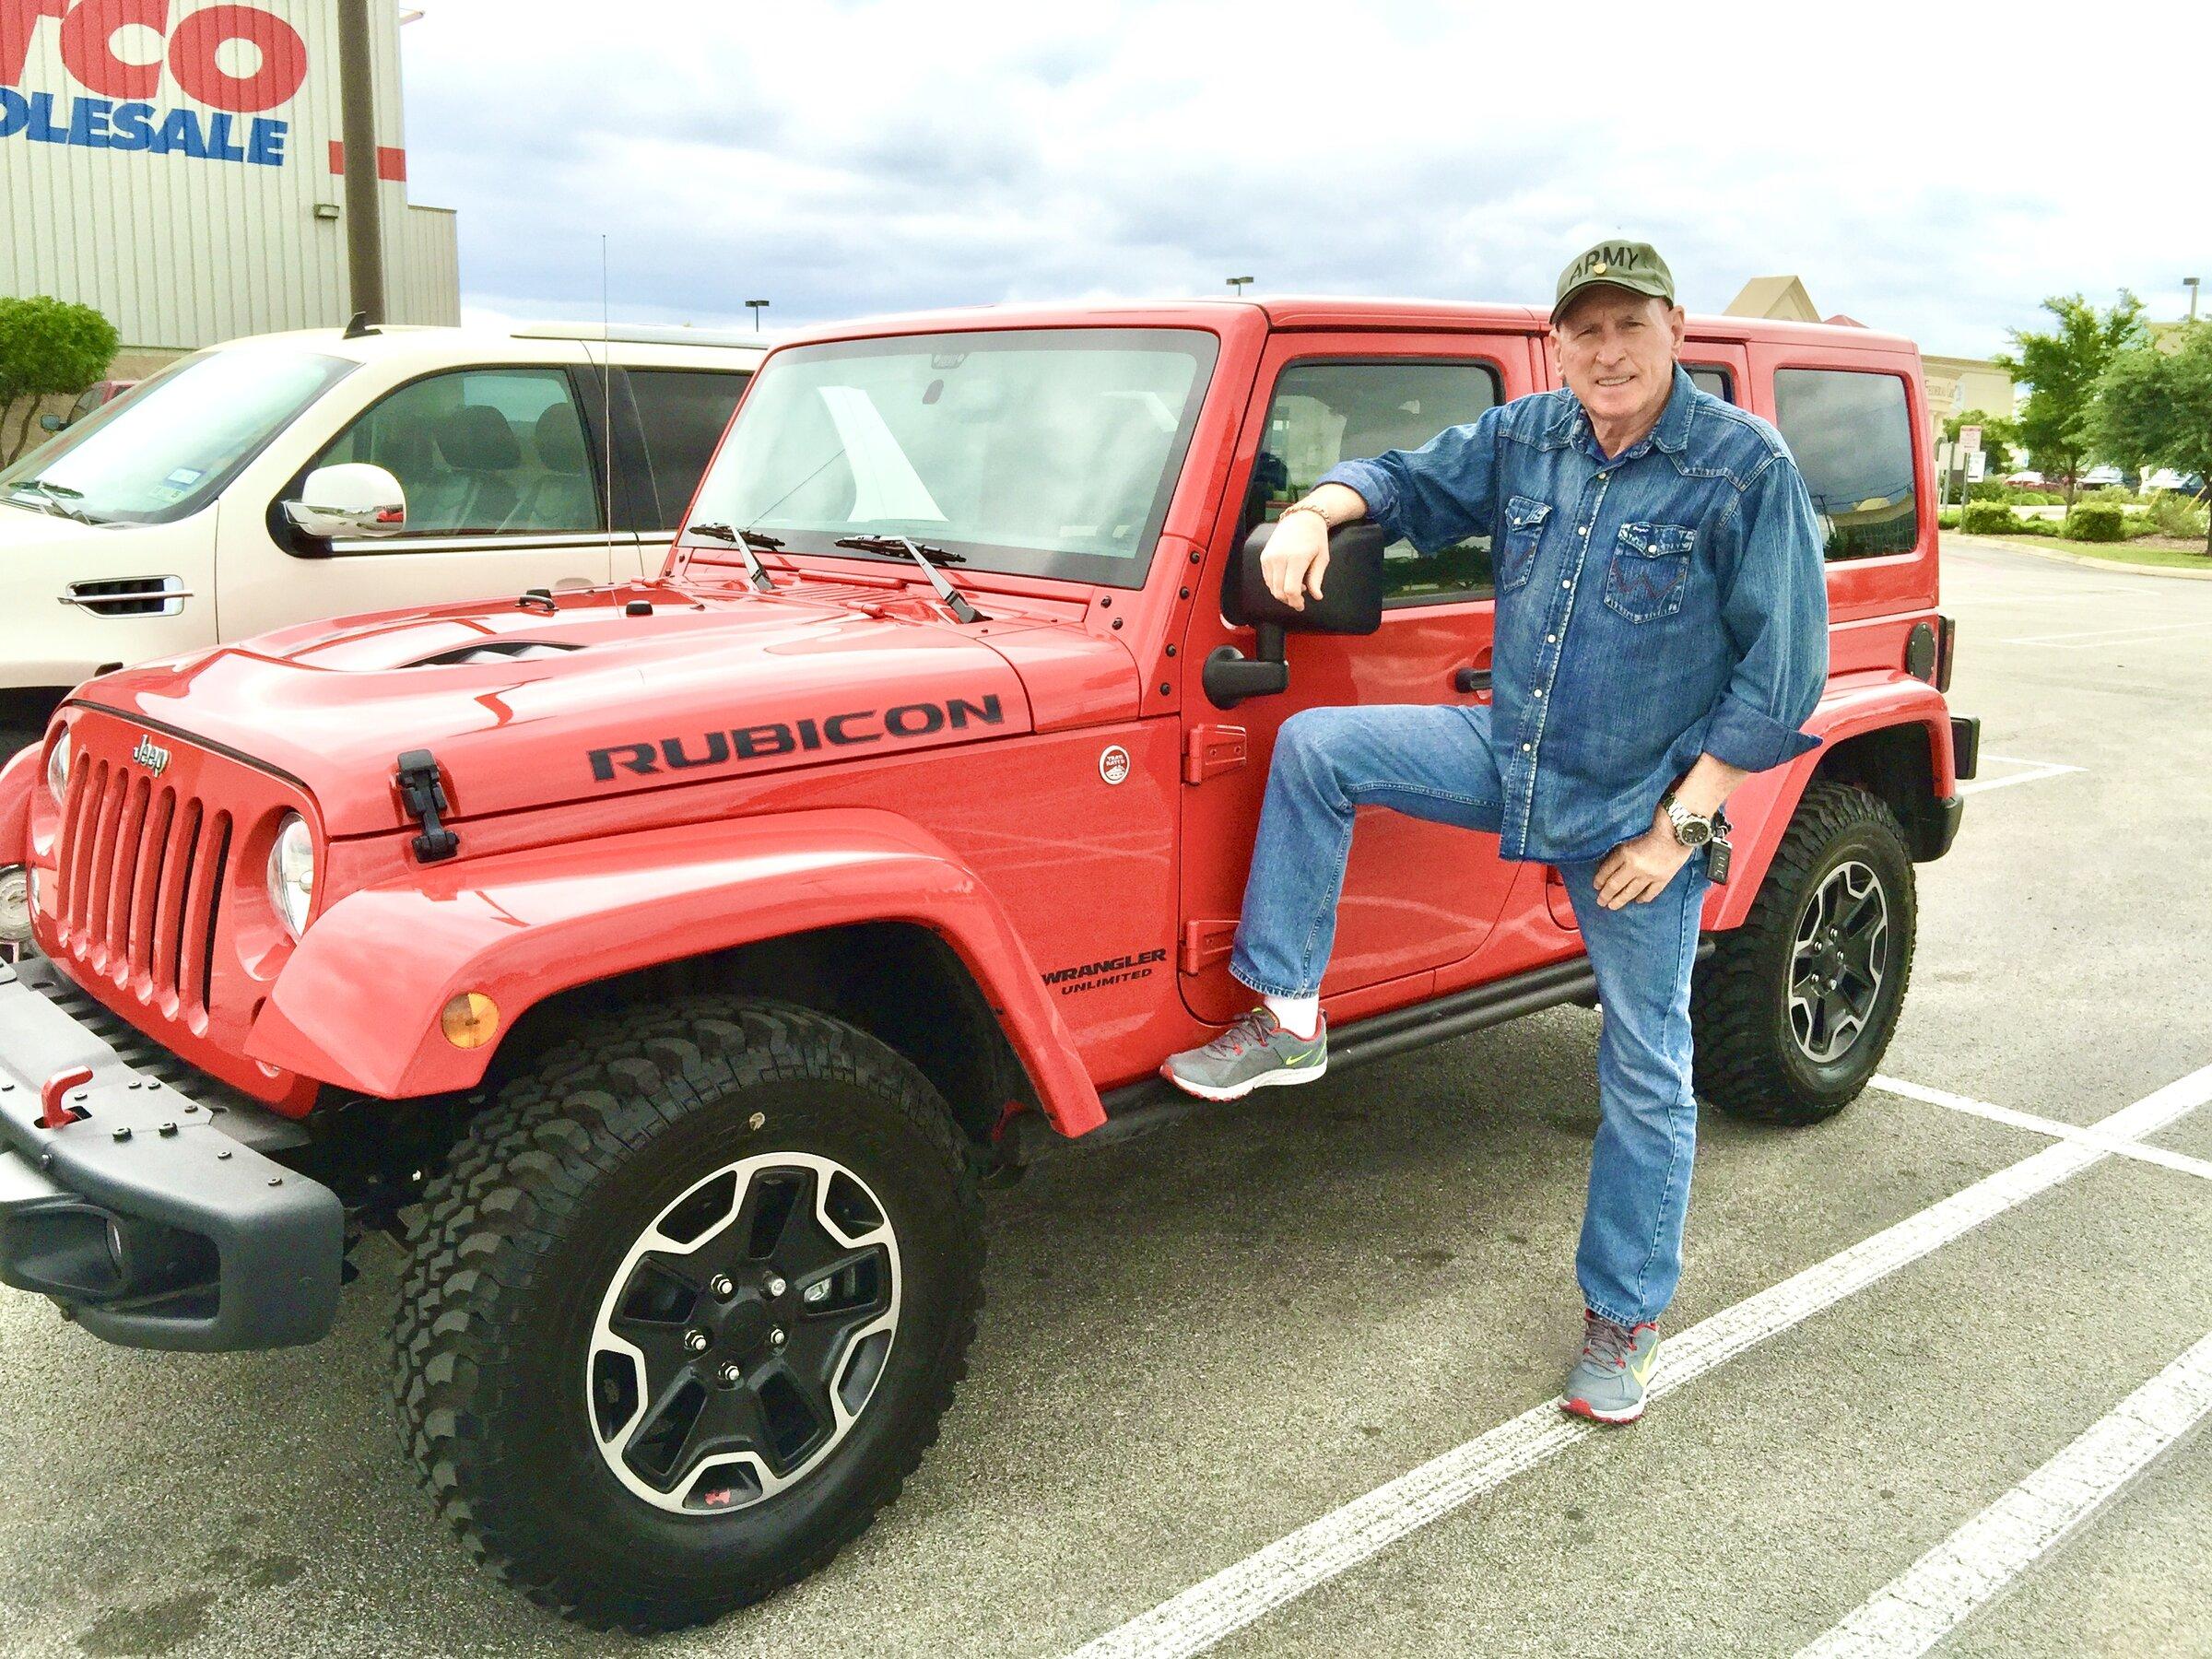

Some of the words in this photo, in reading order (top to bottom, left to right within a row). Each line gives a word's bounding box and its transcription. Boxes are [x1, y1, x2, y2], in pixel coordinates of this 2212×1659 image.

[1569, 246, 1639, 286] ARMY
[133, 734, 170, 778] Jeep
[587, 693, 1005, 782] RUBICON
[1041, 947, 1167, 985] WRANGLER
[1061, 968, 1152, 994] UNLIMITED
